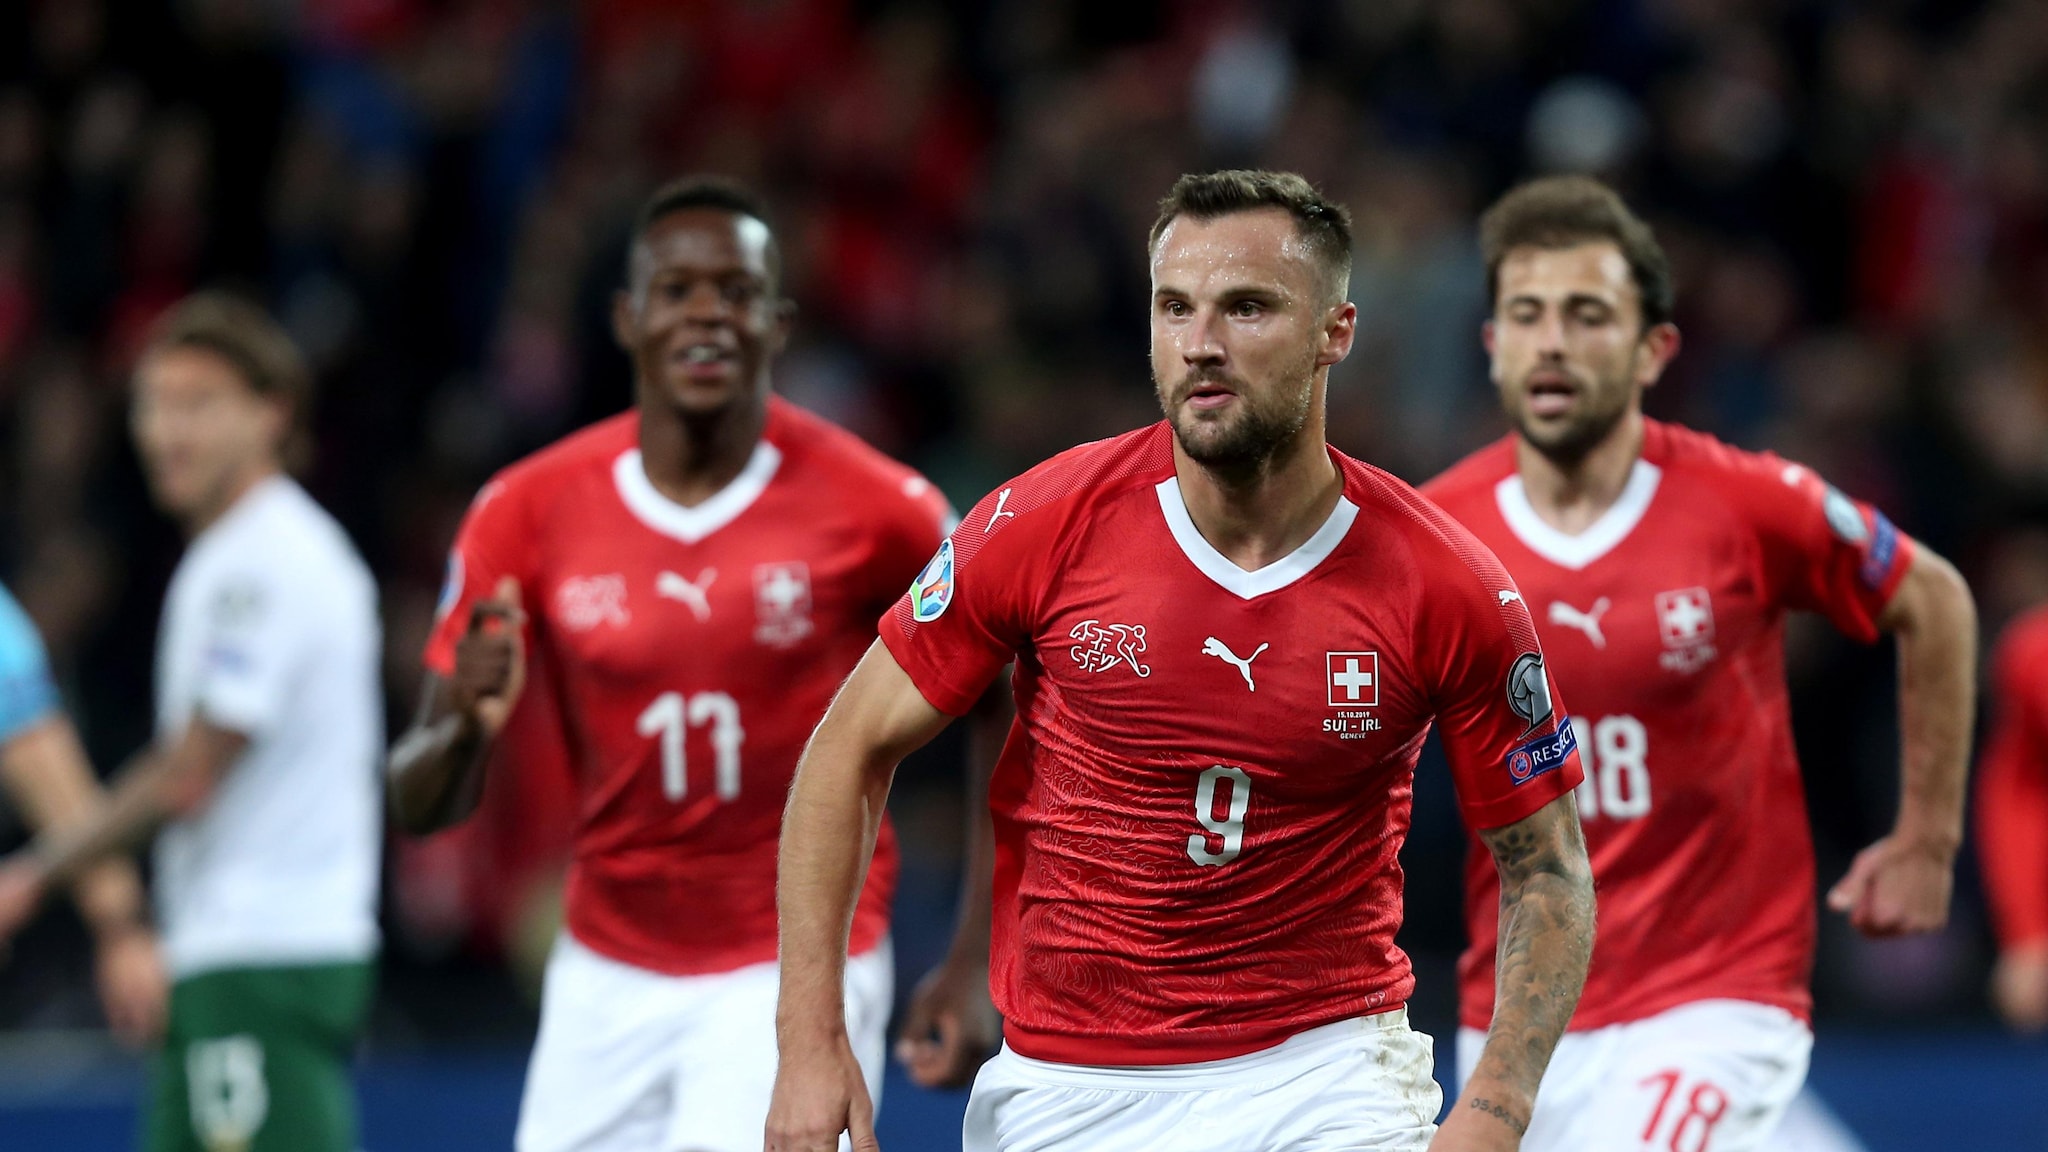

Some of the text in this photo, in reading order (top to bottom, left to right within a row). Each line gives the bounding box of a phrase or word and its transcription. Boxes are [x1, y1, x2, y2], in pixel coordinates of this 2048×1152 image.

[1322, 718, 1347, 732] SUI
[1361, 717, 1382, 732] IRL
[1532, 723, 1573, 766] RESECT
[1186, 765, 1252, 867] 9
[1636, 1066, 1730, 1152] 18
